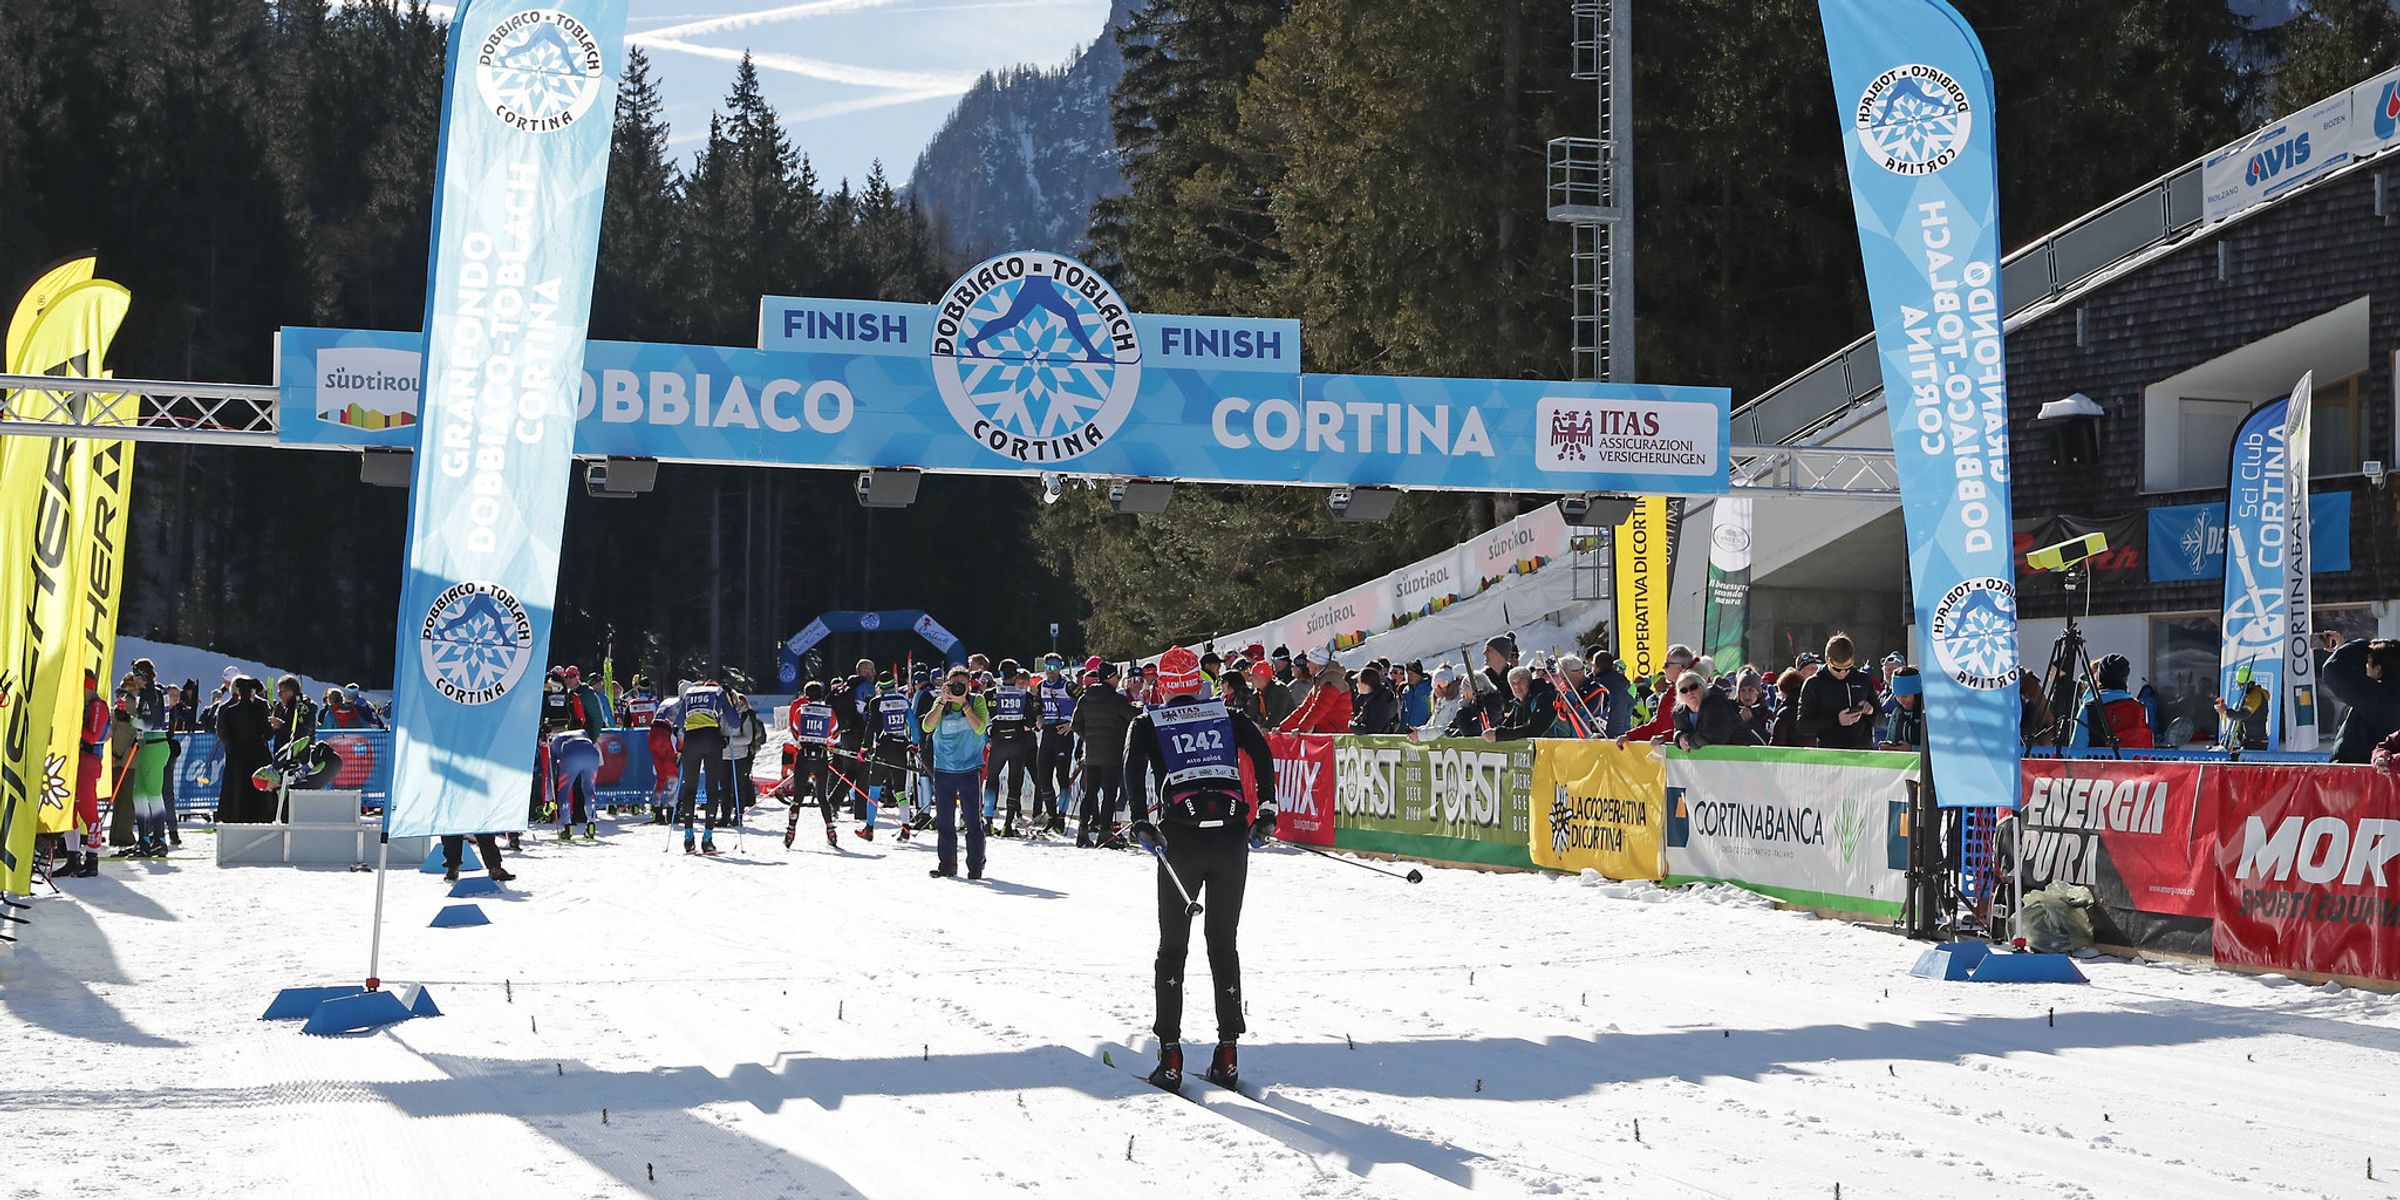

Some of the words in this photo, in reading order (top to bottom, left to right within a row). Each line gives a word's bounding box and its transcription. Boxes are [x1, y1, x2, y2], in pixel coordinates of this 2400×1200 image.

[480, 11, 540, 66] DOBBIACO
[557, 14, 600, 70] TOBLACH
[496, 105, 573, 131] CORTINA
[2245, 131, 2312, 187] AVIS
[784, 309, 908, 344] FINISH
[934, 257, 1024, 355] DOBBIACO
[1052, 259, 1136, 352] TOBLACH
[441, 231, 492, 478] GRANFONDO
[514, 275, 563, 444] CORTINA
[1161, 327, 1281, 360] FINISH
[577, 368, 854, 433] BBIACO
[1600, 410, 1660, 437] ITAS
[973, 420, 1104, 461] CORTINA
[1211, 396, 1495, 457] CORTINA
[1600, 438, 1693, 451] ASSICURAZIONI
[1600, 451, 1706, 465] VERSICHERUNGEN
[2241, 432, 2263, 480] Club
[2239, 487, 2258, 518] Sci
[2258, 424, 2287, 568] CORTINA
[1633, 557, 1648, 573] DI
[423, 583, 476, 640] DOBBIACO
[490, 584, 531, 641] TOBLACH
[436, 678, 505, 704] CORTINA
[806, 719, 823, 730] 1114
[1171, 730, 1224, 755] 1242
[1334, 745, 1402, 819] FORST
[1428, 747, 1508, 829] FORST
[1694, 800, 1824, 846] CORTINABANCA
[2027, 777, 2168, 835] ENERGIA
[1581, 825, 1622, 852] CORTINA
[2009, 830, 2098, 886] PURA
[2239, 889, 2313, 920] SPORTS
